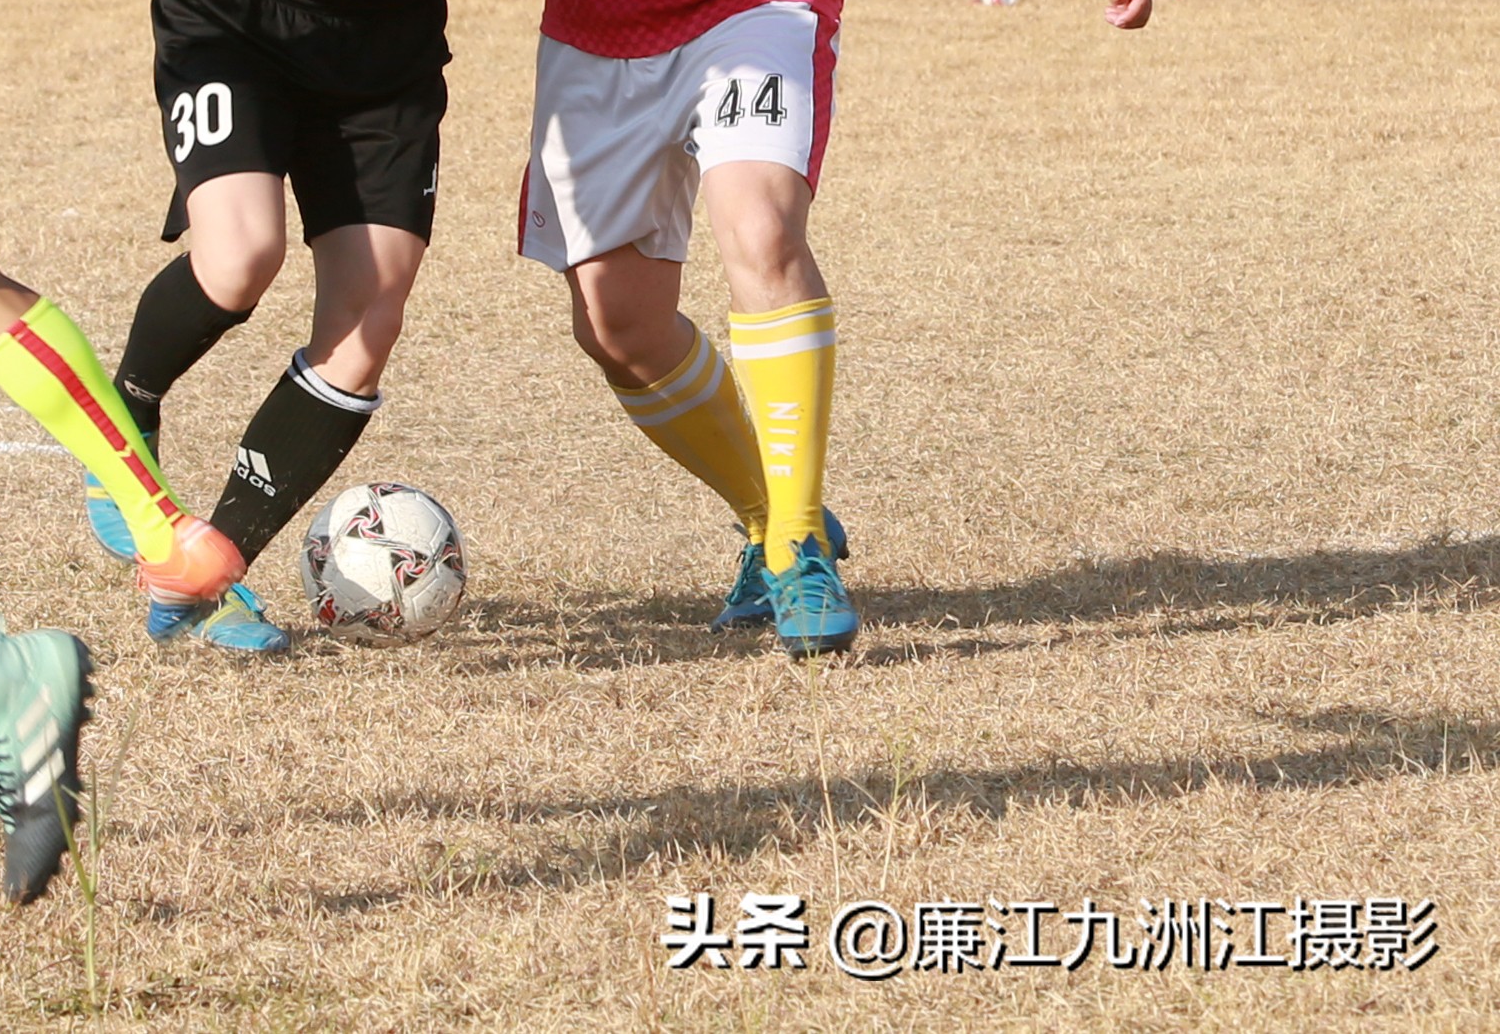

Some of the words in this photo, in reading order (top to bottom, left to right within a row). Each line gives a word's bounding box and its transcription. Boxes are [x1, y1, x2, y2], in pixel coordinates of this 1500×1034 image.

[170, 81, 234, 163] 30
[714, 73, 788, 128] 44
[766, 401, 801, 478] NIKE
